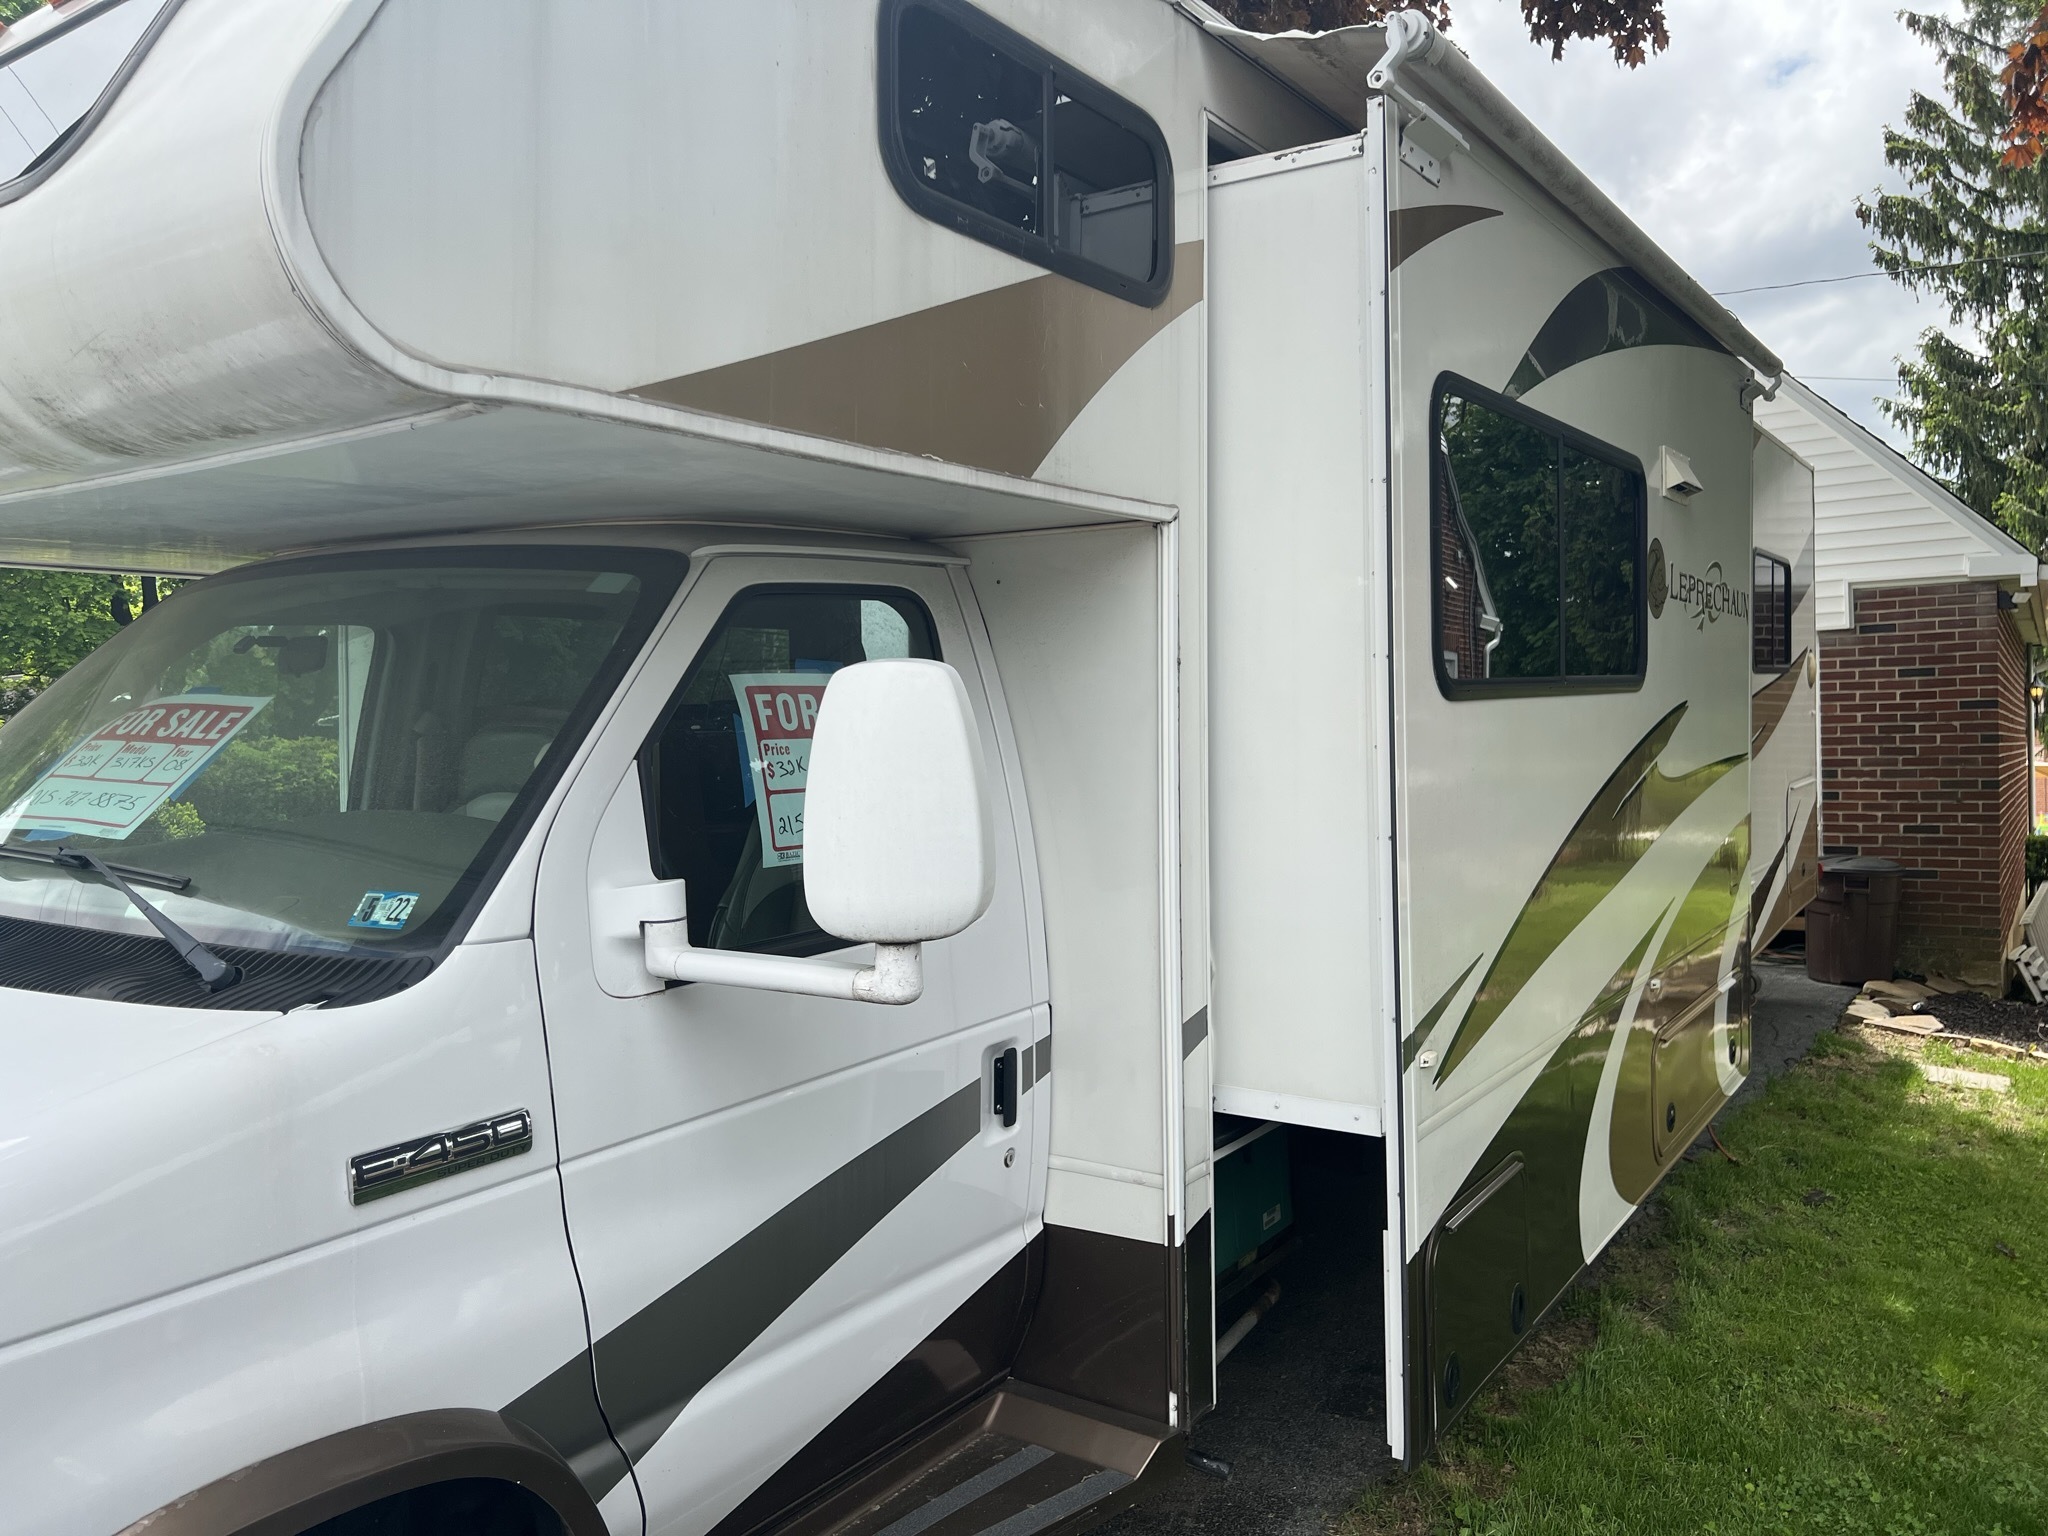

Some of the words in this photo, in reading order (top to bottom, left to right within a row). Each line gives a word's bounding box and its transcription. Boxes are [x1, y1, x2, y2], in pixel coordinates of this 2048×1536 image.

[1670, 562, 1749, 624] LEPRECHAUN
[101, 708, 166, 736] FOR
[157, 708, 244, 740] SALE
[754, 692, 818, 731] FOR
[81, 742, 103, 752] Price
[120, 744, 152, 756] Model
[172, 747, 194, 758] Year
[763, 743, 791, 756] Price
[385, 897, 411, 922] 22
[437, 1157, 486, 1178] SUPER
